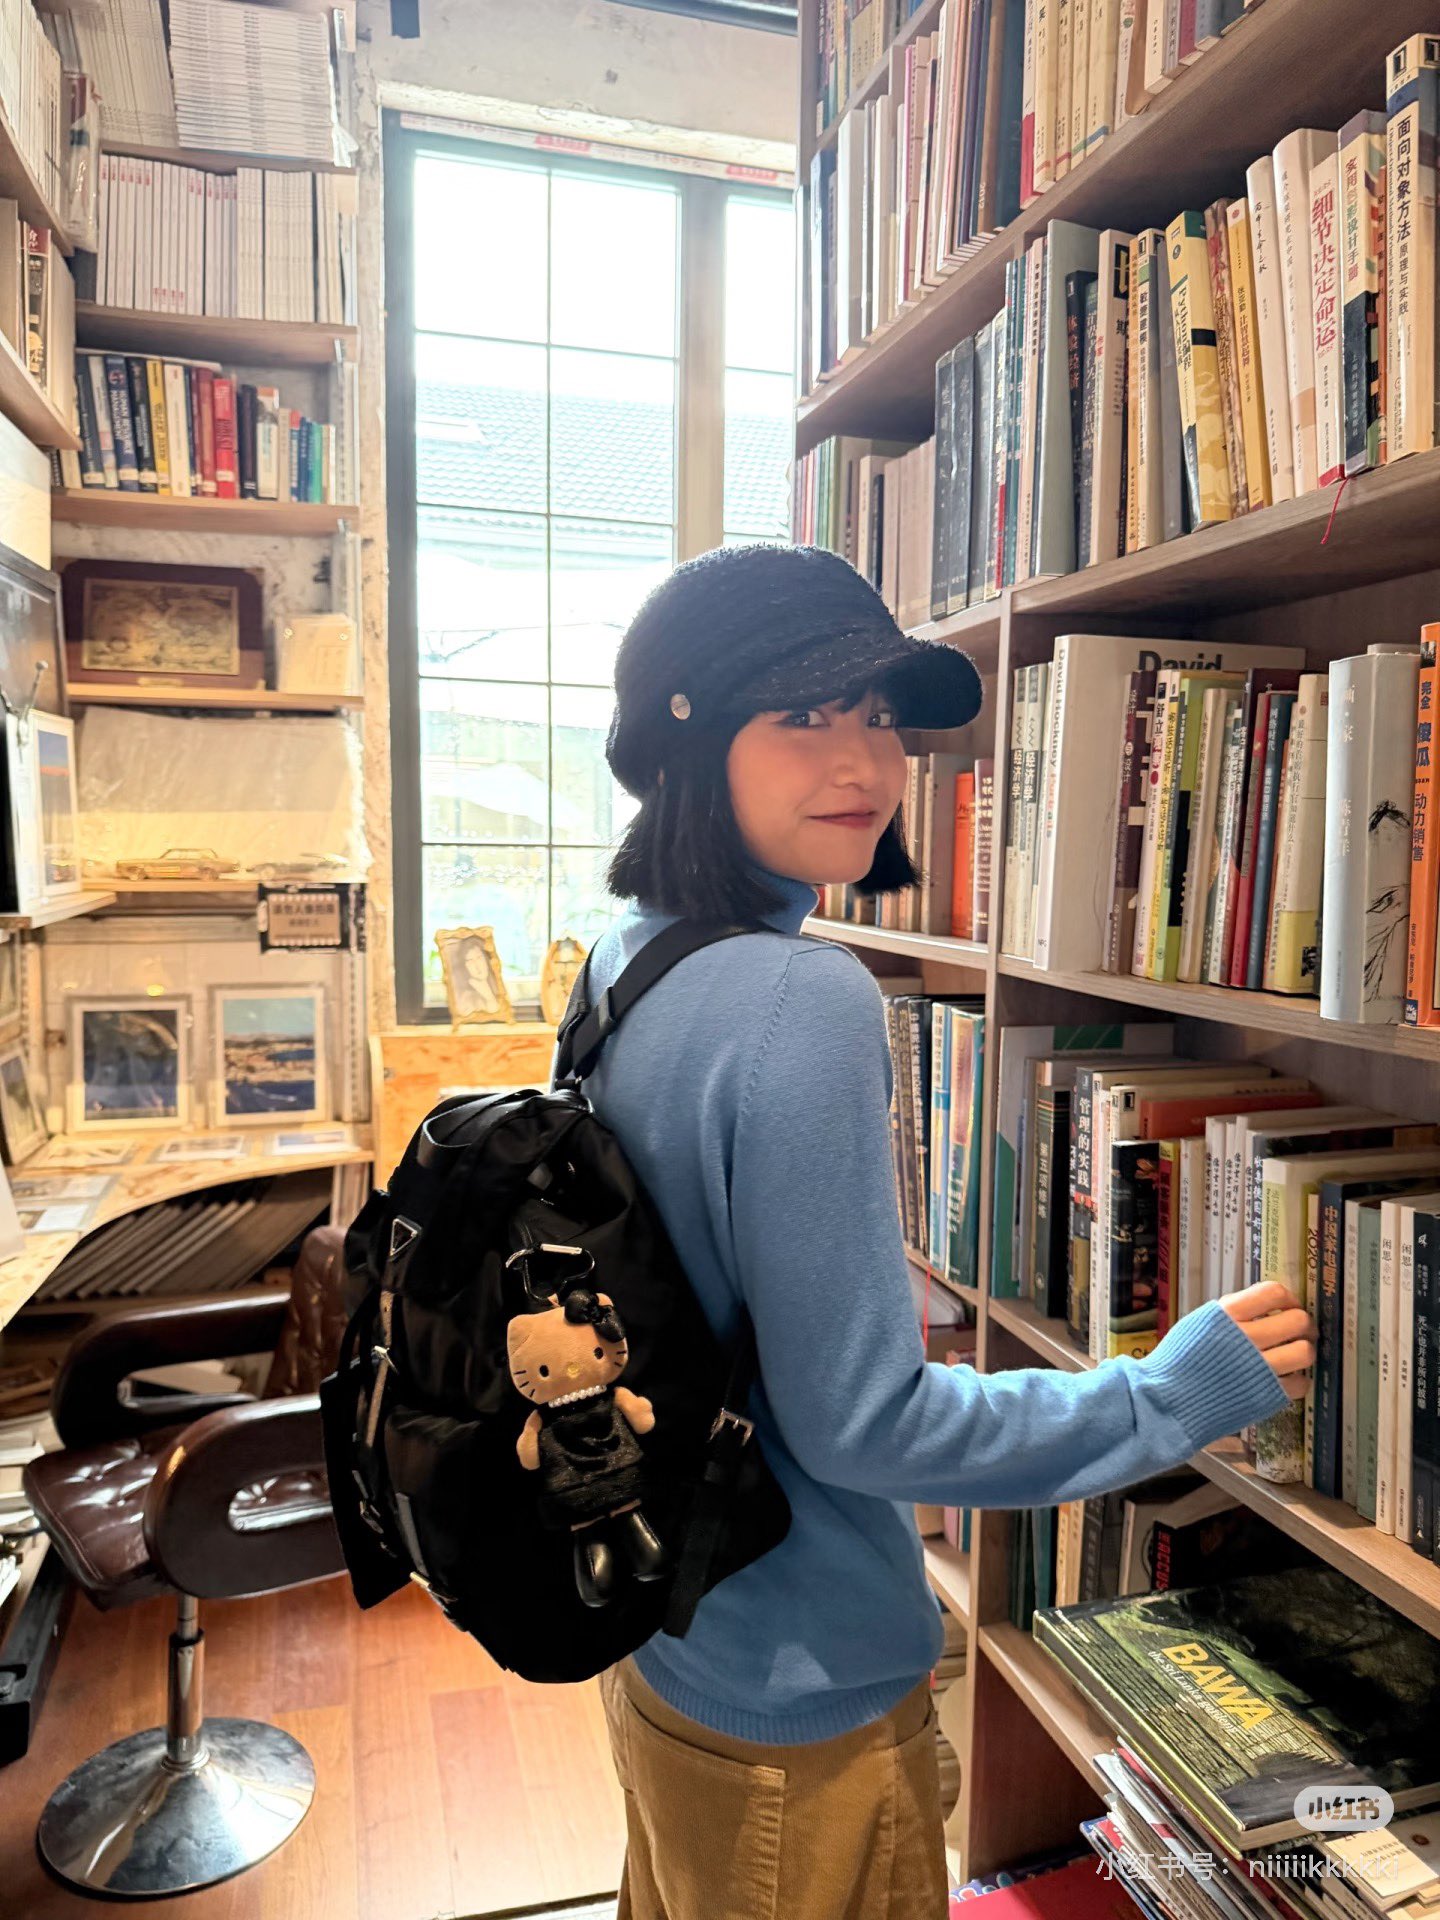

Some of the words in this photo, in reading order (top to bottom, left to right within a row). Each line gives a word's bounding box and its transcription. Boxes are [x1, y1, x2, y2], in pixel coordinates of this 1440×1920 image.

[1311, 190, 1336, 350] 细节决定命运
[1055, 648, 1065, 694] David
[1421, 680, 1433, 710] 完全
[1050, 698, 1063, 767] Hockney
[1416, 722, 1433, 768] 傻瓜
[1011, 750, 1023, 797] 经济学
[1023, 751, 1036, 800] 经济学
[1412, 793, 1428, 862] 动力销售
[1077, 1097, 1091, 1189] 管理的实践
[1306, 1228, 1319, 1283] 2020年
[1162, 1643, 1274, 1731] BAWA
